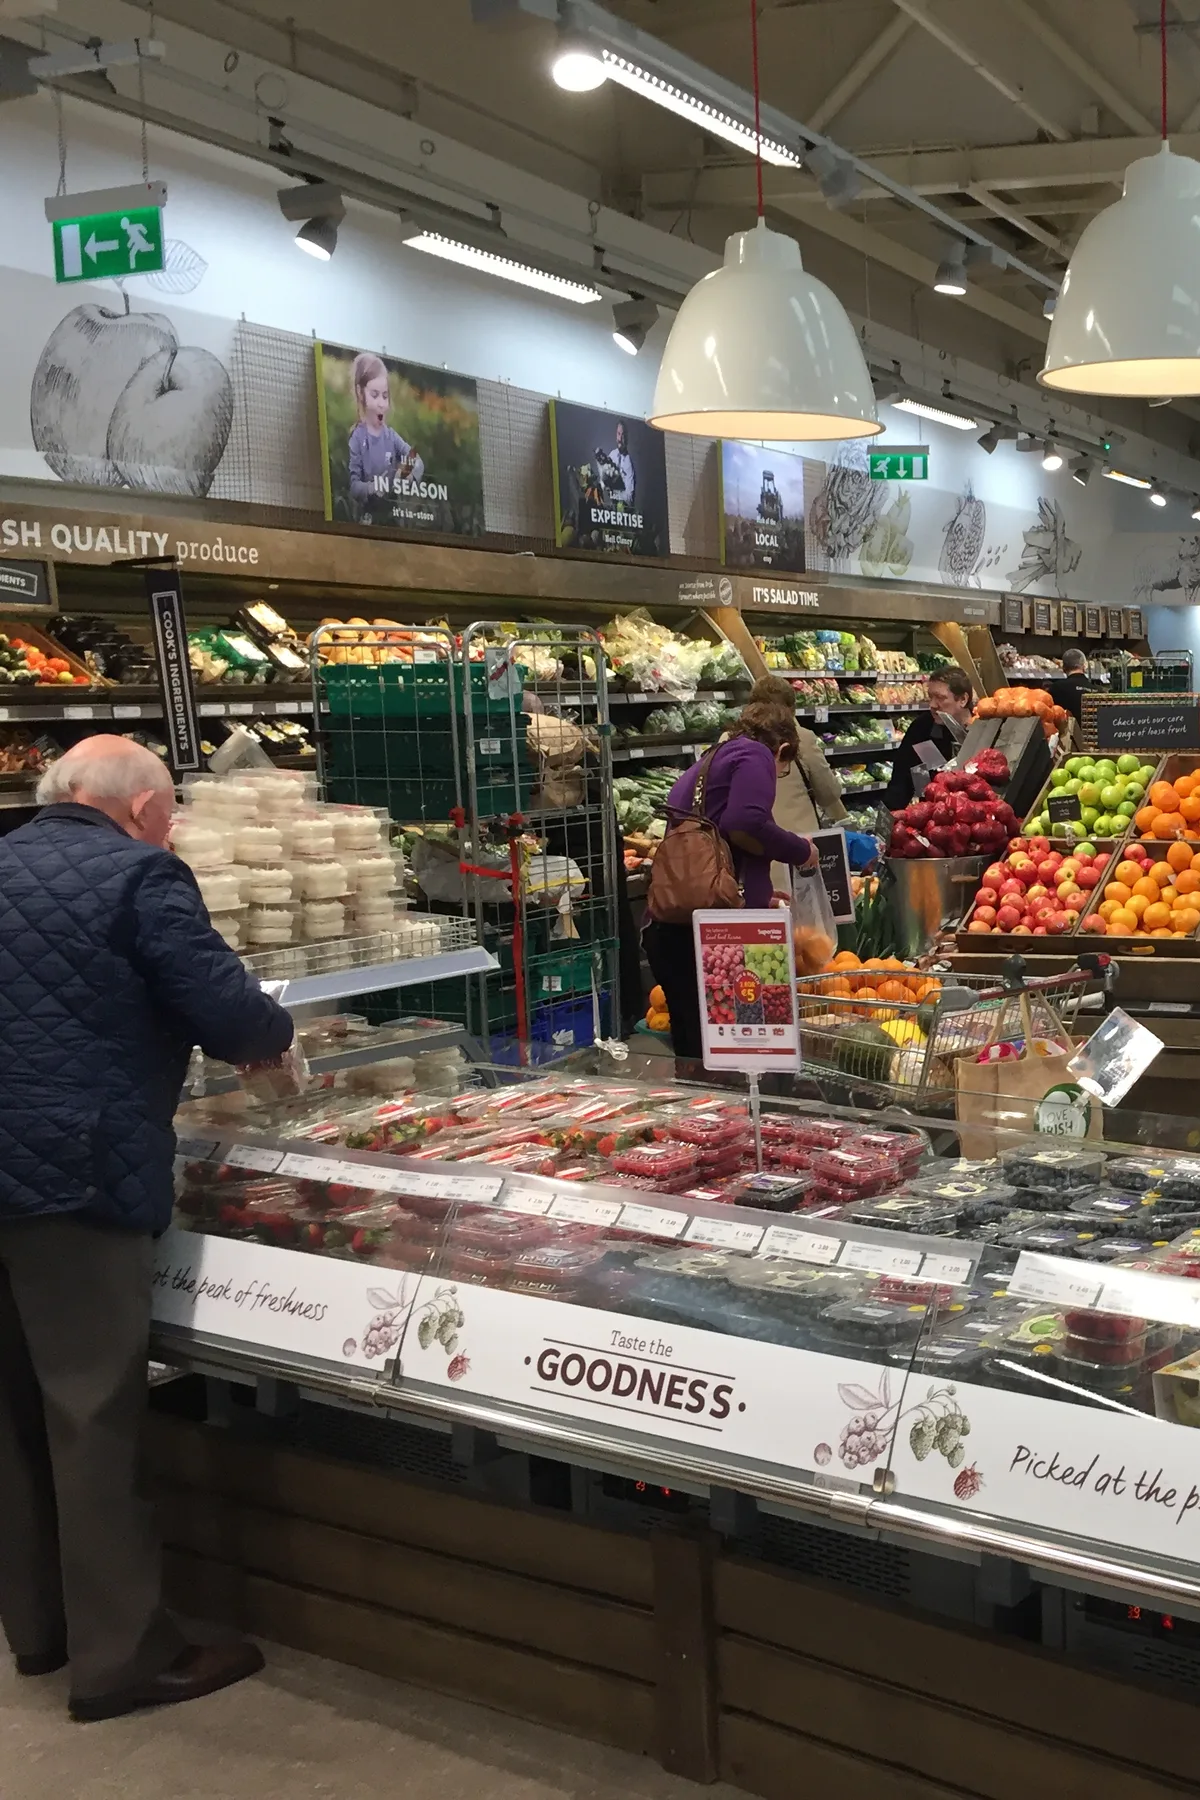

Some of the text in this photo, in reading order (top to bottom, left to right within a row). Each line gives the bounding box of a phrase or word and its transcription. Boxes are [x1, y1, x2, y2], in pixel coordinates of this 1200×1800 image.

[374, 475, 448, 500] IN SEASON
[405, 509, 434, 521] in-store
[591, 508, 643, 528] EXPERTISE
[0, 518, 259, 565] SH QUALITY produce
[755, 533, 779, 547] LOCAL
[753, 587, 819, 607] IT'S SALAD TIME
[163, 611, 189, 750] COOK'S INGREDIENTS
[1113, 716, 1136, 726] Check
[1137, 715, 1150, 725] out
[1114, 725, 1187, 742] range of loose fruit
[741, 989, 755, 1002] €5
[172, 1266, 195, 1293] the
[192, 1275, 231, 1304] peak
[235, 1280, 255, 1308] of
[250, 1282, 328, 1322] freshness
[610, 1330, 673, 1357] Taste the
[537, 1349, 734, 1419] GOODNESS
[1009, 1444, 1100, 1490] Picked
[1094, 1466, 1126, 1496] at
[1134, 1468, 1177, 1508] the
